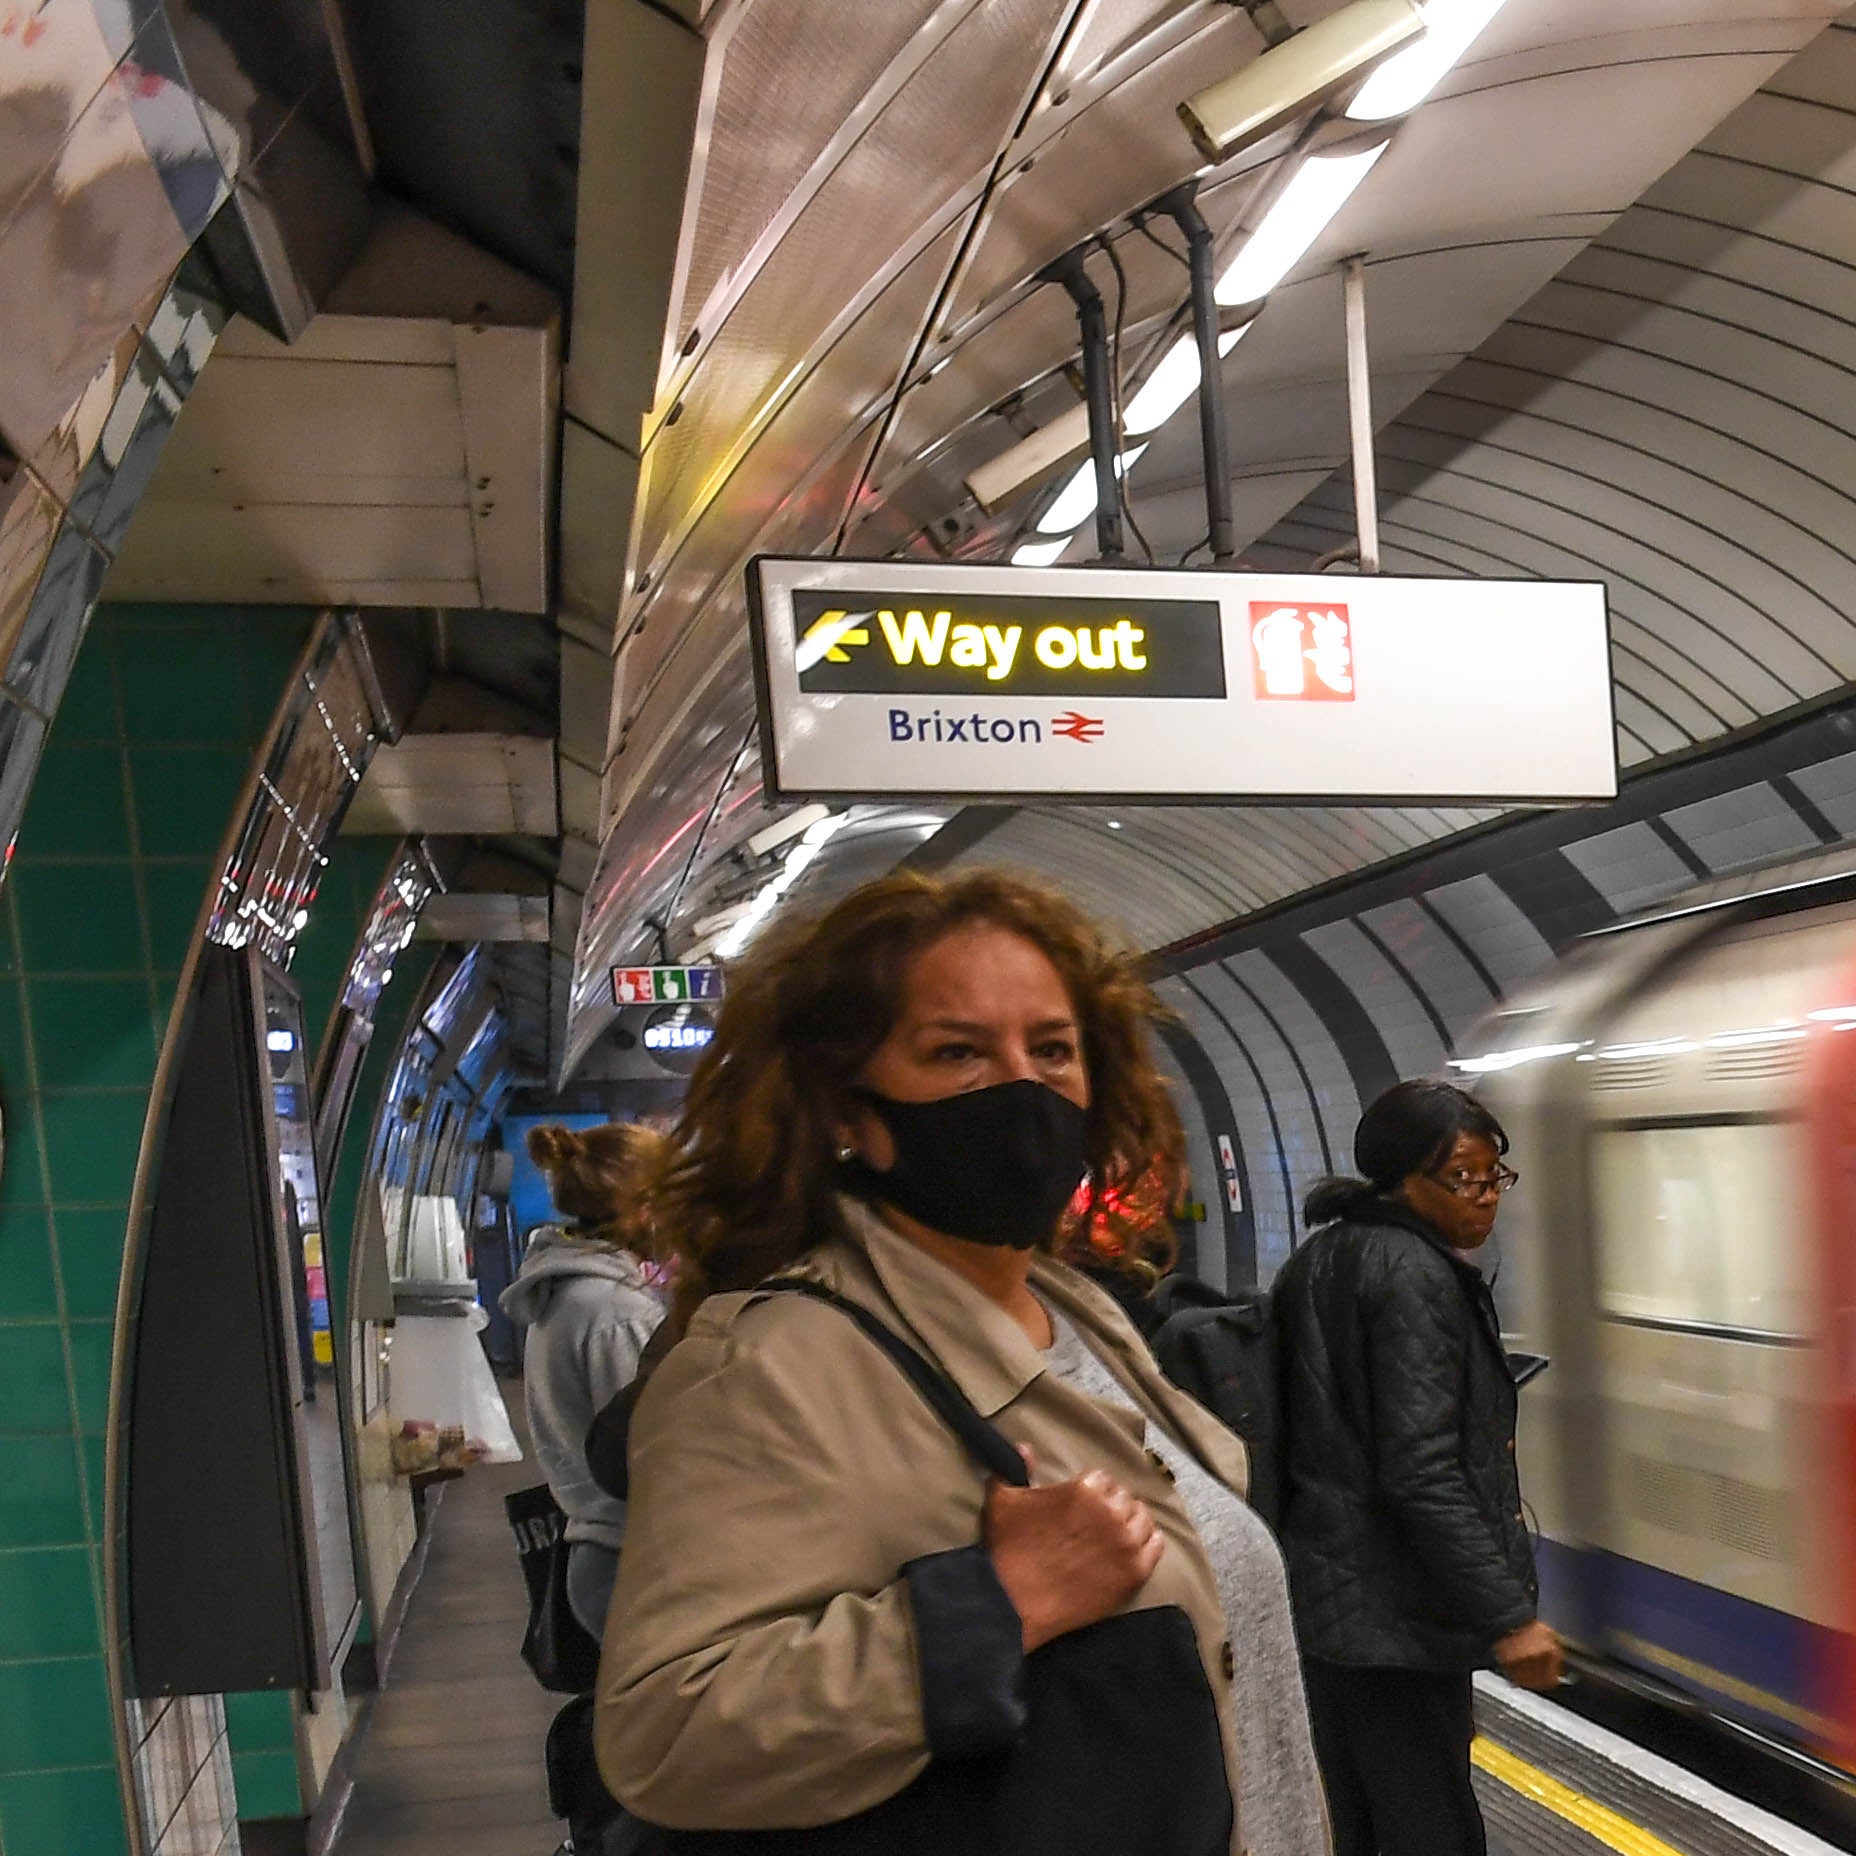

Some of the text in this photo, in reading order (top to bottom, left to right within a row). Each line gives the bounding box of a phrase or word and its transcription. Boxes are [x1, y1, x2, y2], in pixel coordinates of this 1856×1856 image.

[877, 610, 1147, 681] Way out
[889, 709, 1042, 743] Brixton
